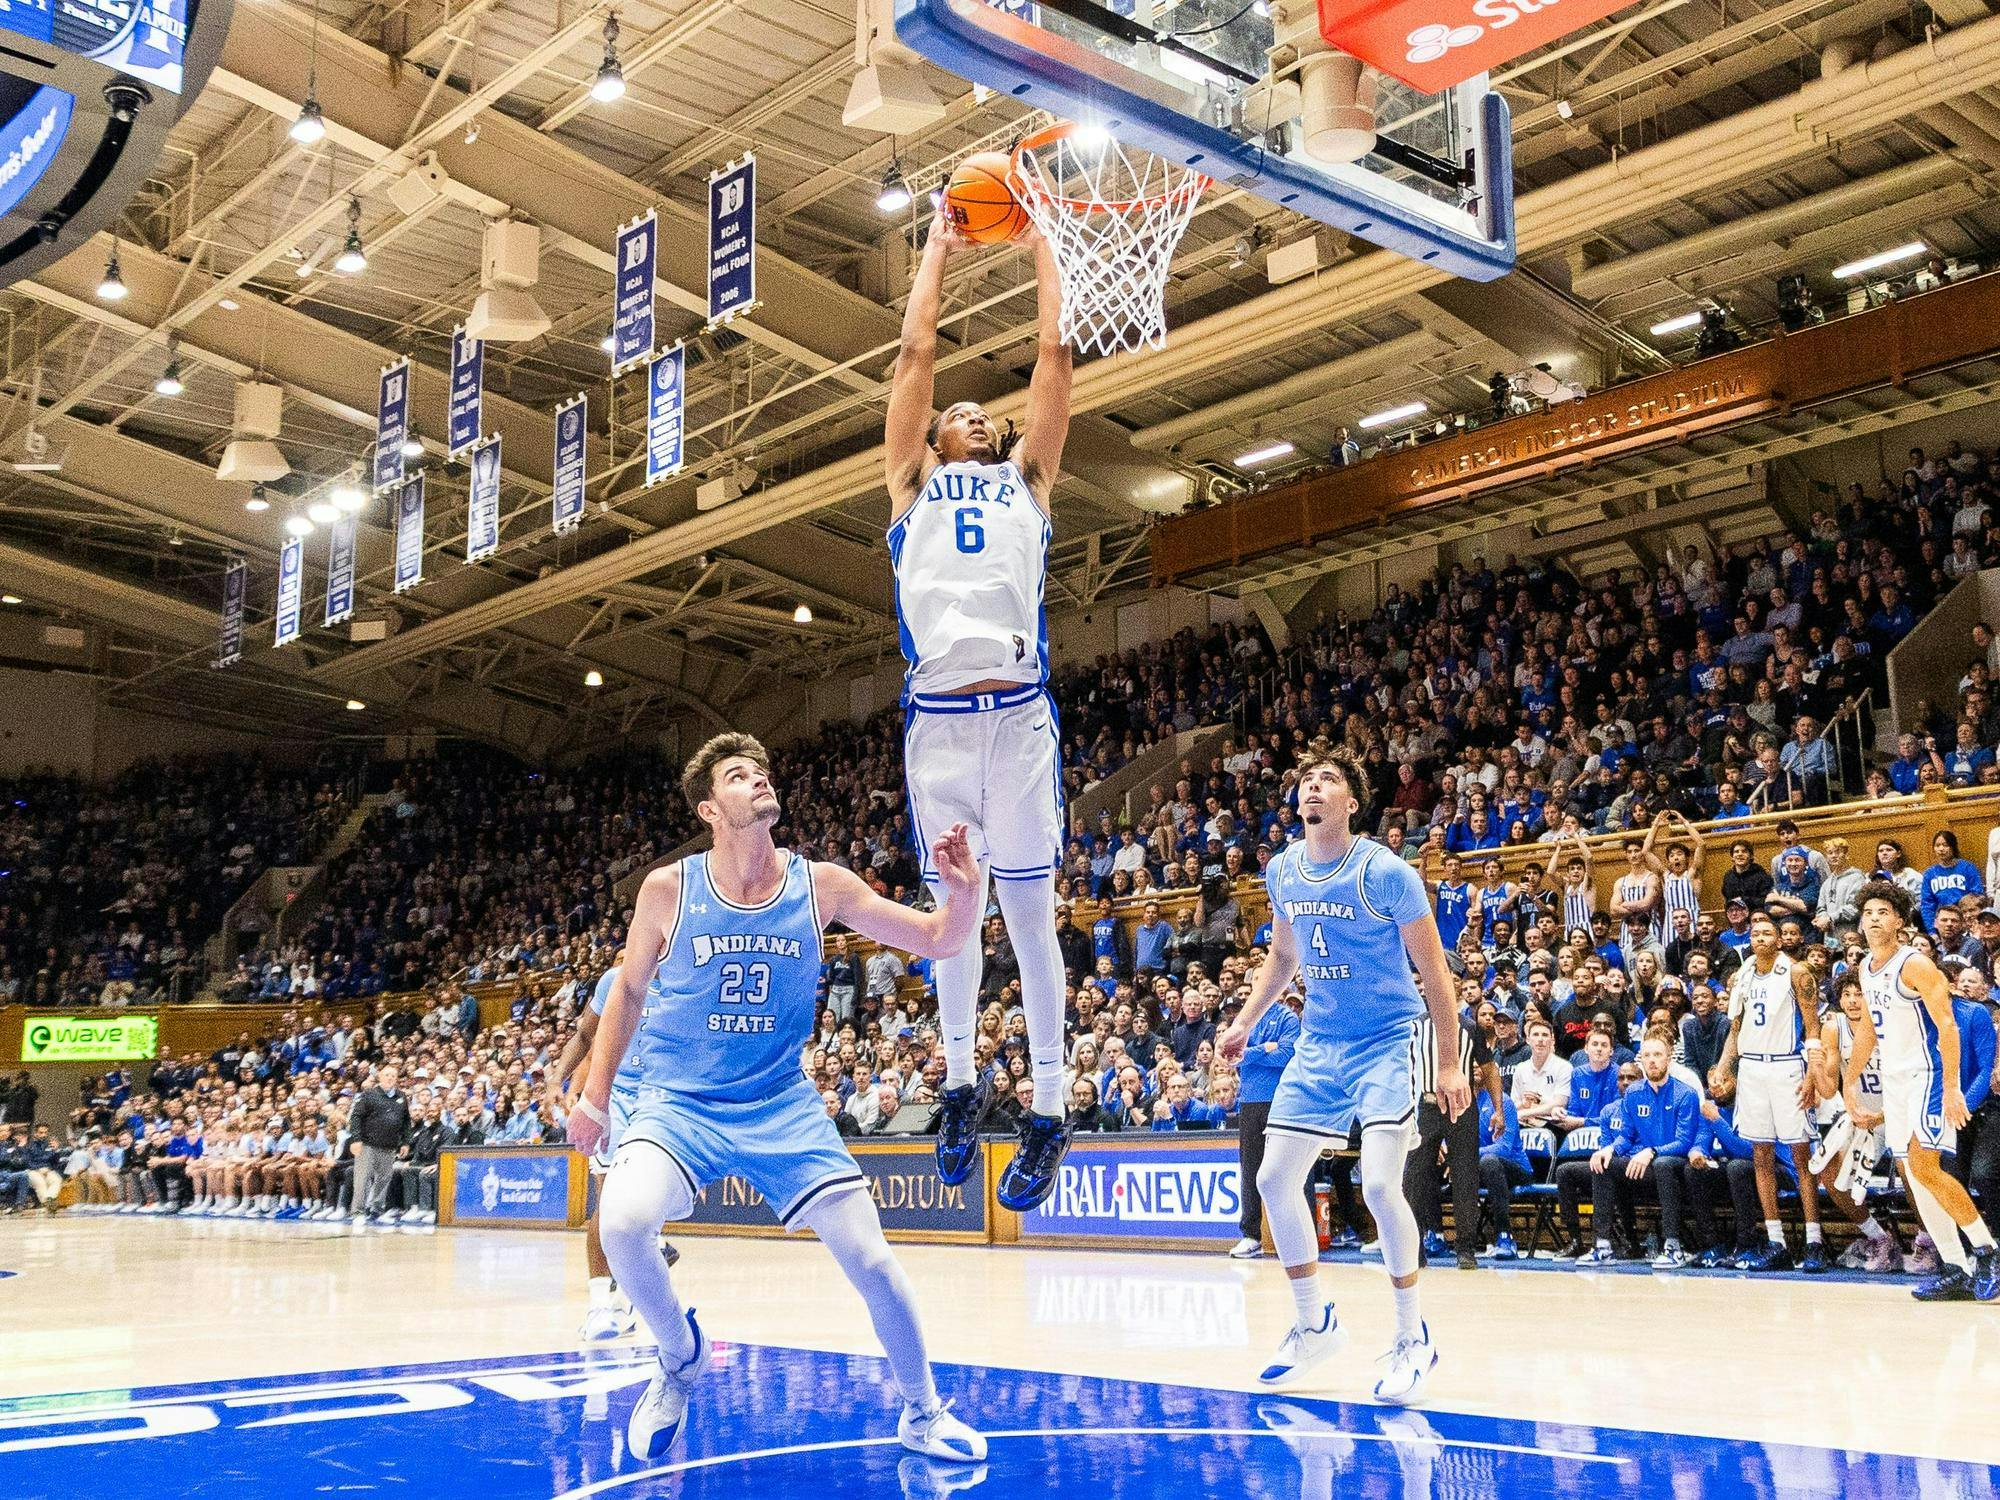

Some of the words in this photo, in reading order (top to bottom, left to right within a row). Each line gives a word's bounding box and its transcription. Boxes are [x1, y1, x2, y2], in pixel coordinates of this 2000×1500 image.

[721, 222, 740, 240] NCAA
[714, 236, 746, 261] WOMEN'S
[712, 263, 730, 281] FINAL
[730, 253, 750, 274] FOUR
[1410, 440, 1517, 487] CAMERON
[1526, 413, 1619, 453] INDOOR
[1627, 375, 1746, 427] STADIUM
[928, 474, 1014, 508] DUKE
[955, 507, 985, 554] 6
[1440, 890, 1463, 903] DUKE
[1930, 874, 1966, 894] DUKE
[1283, 900, 1356, 925] INDIANA
[691, 933, 802, 967] INDIANA
[1311, 923, 1329, 957] 4
[719, 962, 772, 1005] 23
[1305, 964, 1350, 980] STATE
[707, 1013, 775, 1033] STATE
[1753, 1002, 1766, 1026] 3
[56, 1027, 122, 1043] wave
[1567, 1130, 1601, 1151] DUK
[869, 1174, 966, 1210] ADIUM
[1127, 1171, 1239, 1215] NEWS
